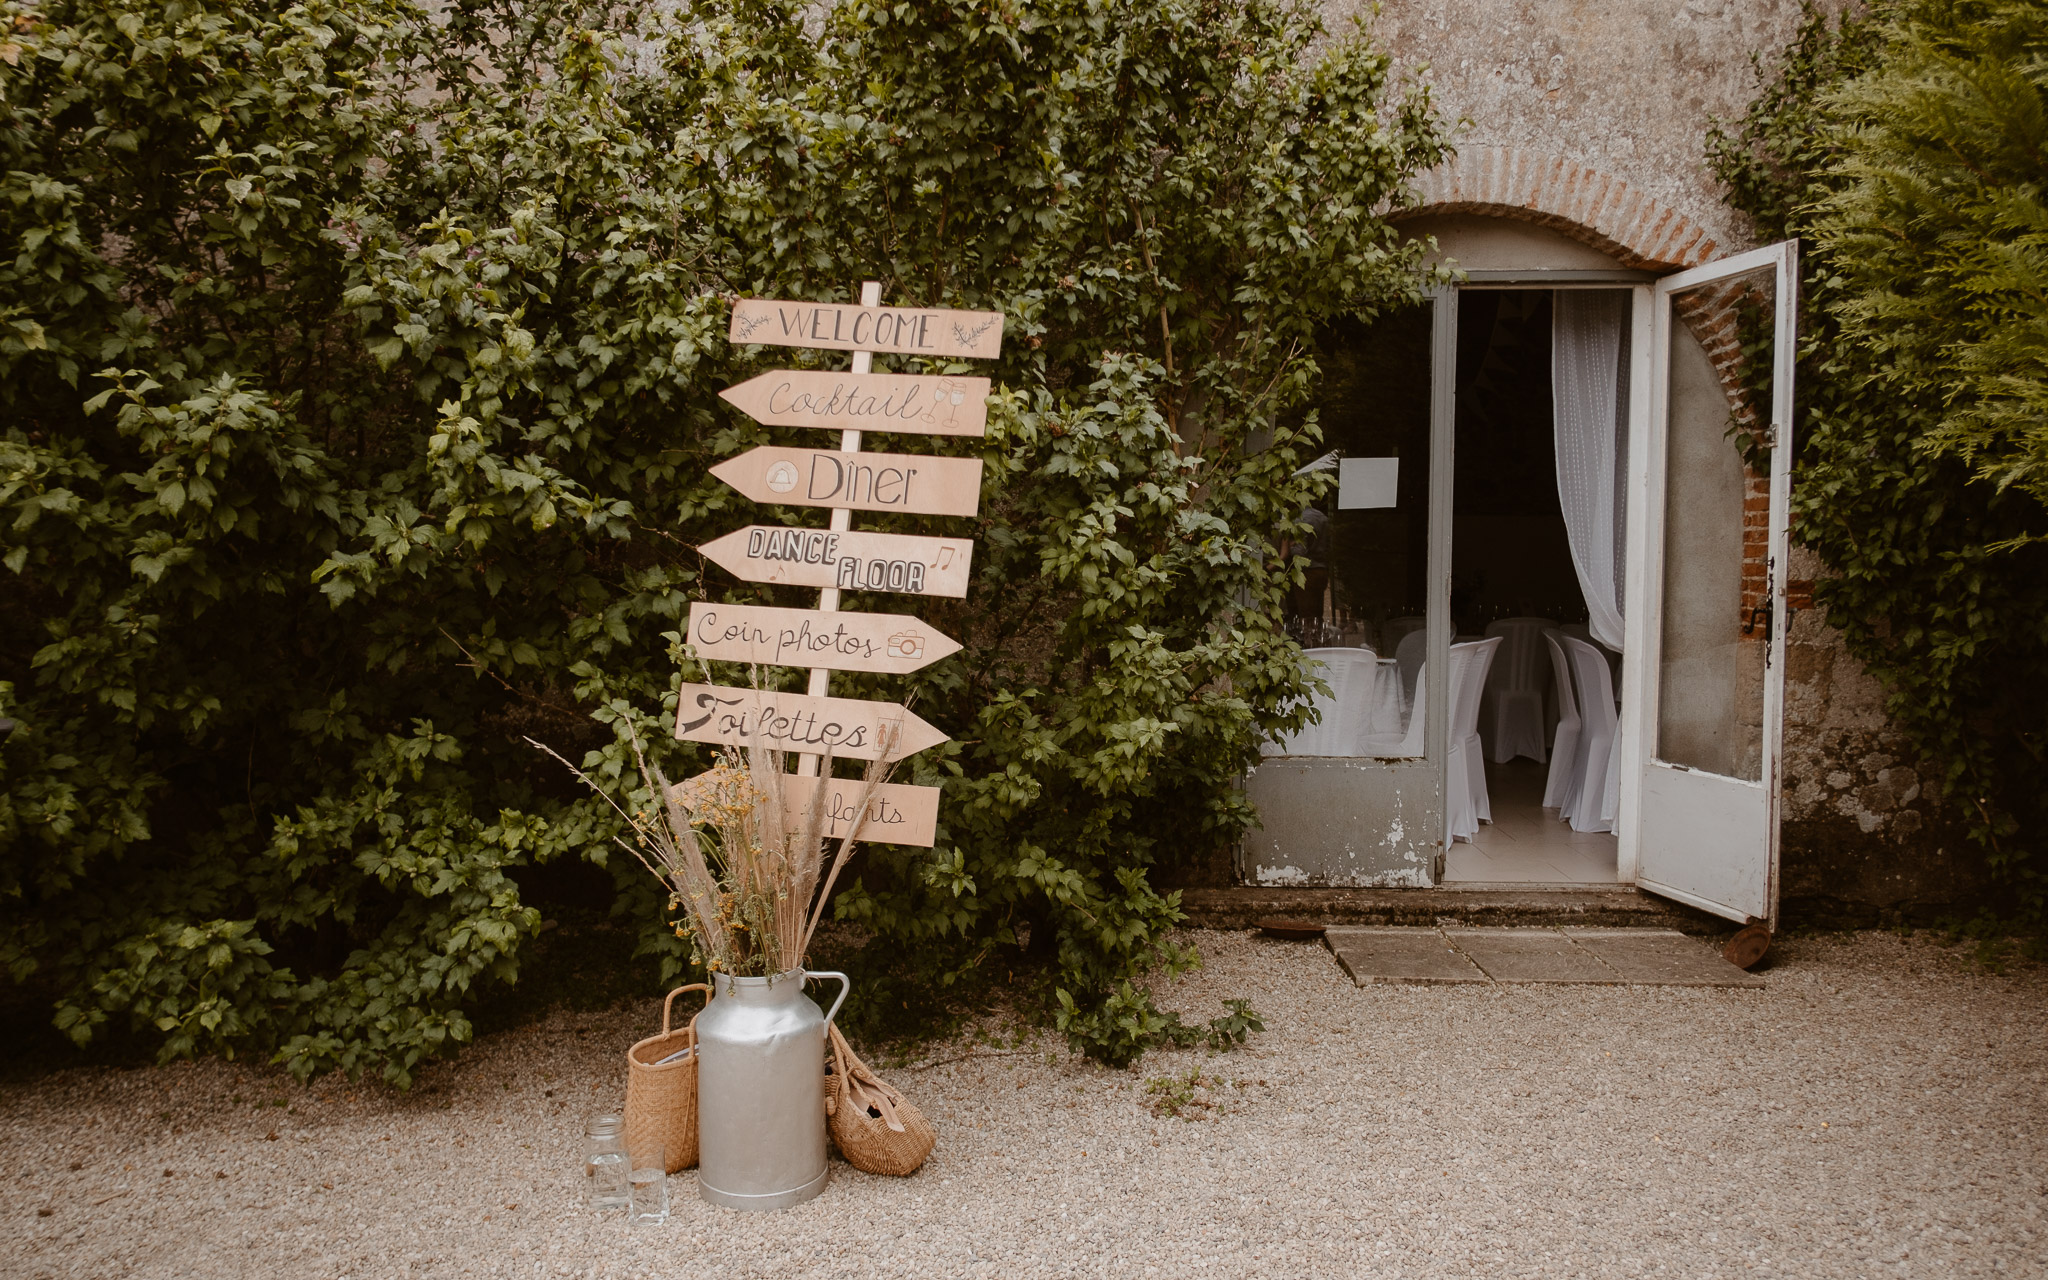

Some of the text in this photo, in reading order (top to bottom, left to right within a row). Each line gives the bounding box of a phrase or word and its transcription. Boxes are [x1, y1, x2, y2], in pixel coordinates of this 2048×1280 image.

[779, 308, 939, 348] WELCOME
[768, 382, 923, 420] Cocktail
[807, 454, 917, 504] Dîner
[747, 528, 840, 565] DANCE
[836, 556, 926, 592] FLOOR
[697, 612, 882, 662] Coin photos
[682, 693, 868, 748] Toilettes
